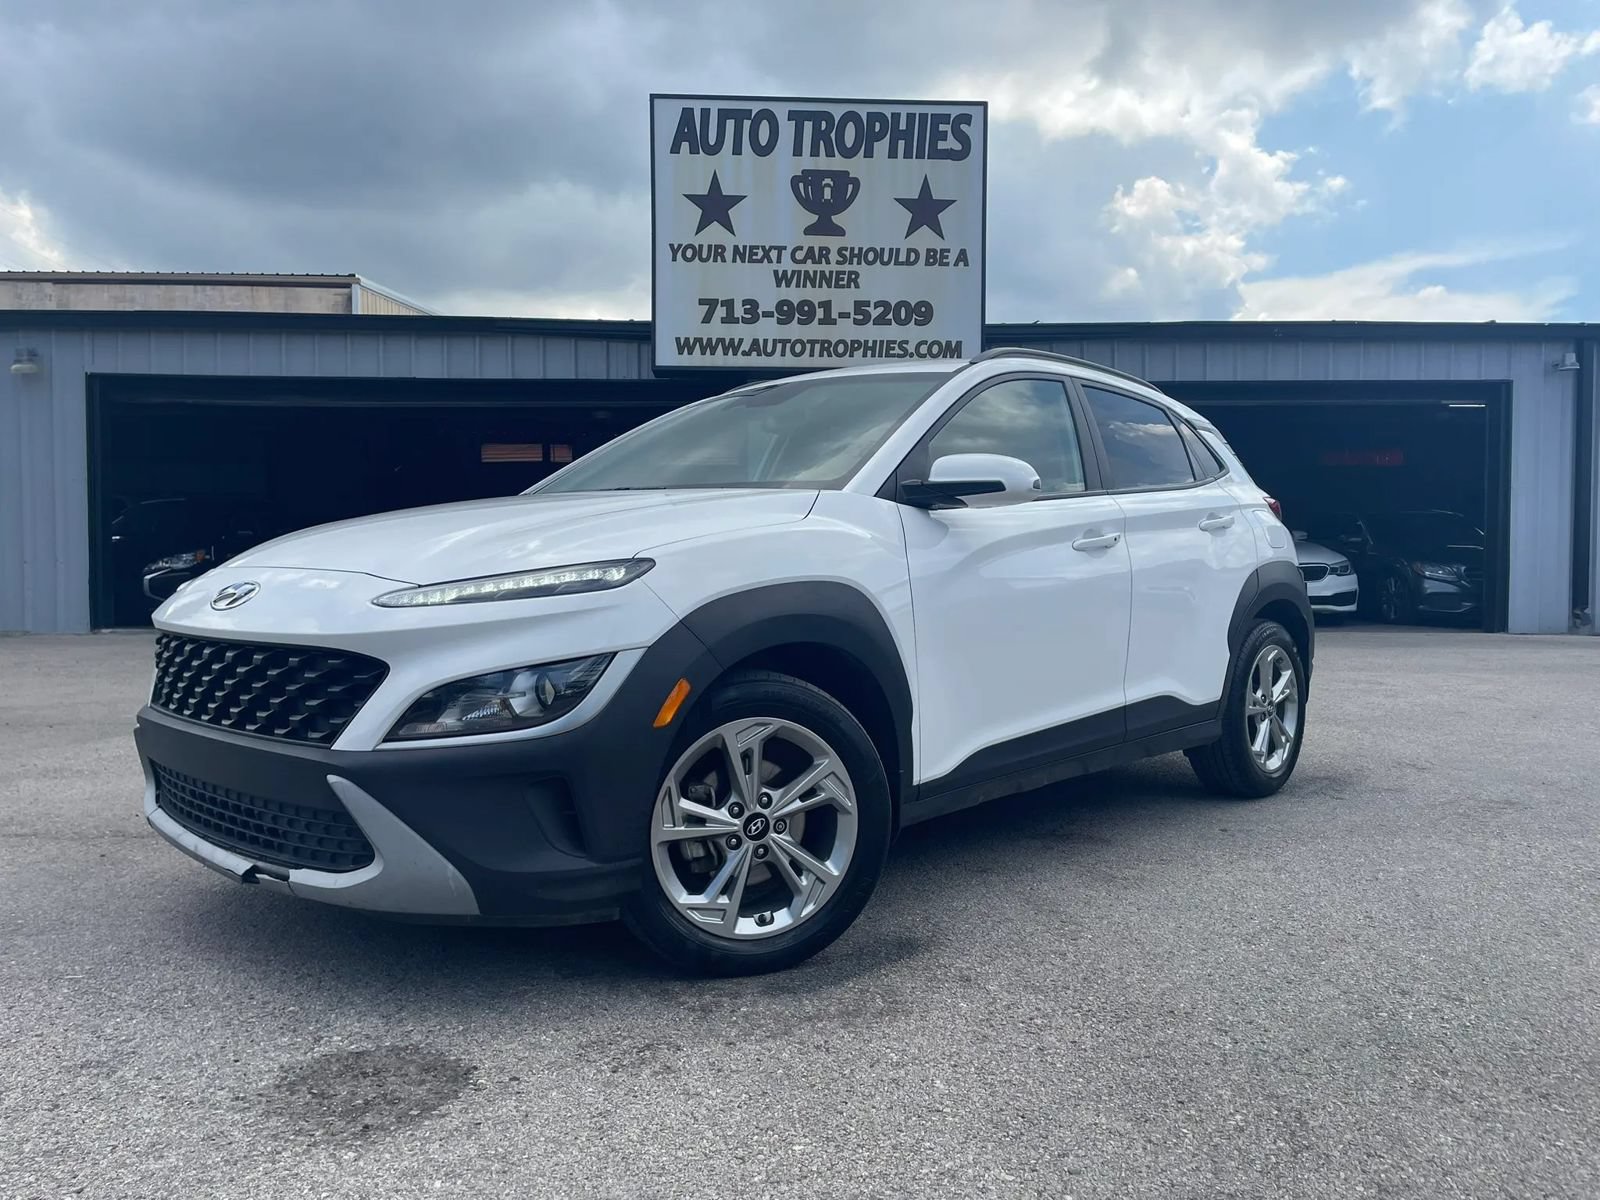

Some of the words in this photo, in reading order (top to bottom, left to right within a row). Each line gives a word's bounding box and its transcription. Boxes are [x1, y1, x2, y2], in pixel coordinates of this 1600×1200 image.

[669, 107, 780, 157] AUTO
[787, 109, 973, 161] TROPHIES
[668, 243, 727, 264] YOUR
[731, 245, 787, 265] NEXT
[790, 246, 831, 266] CAR
[835, 246, 920, 267] SHOULD
[924, 248, 951, 267] BE
[953, 248, 970, 267] A
[773, 269, 860, 289] WINNER
[698, 298, 934, 326] 713-991-5209
[675, 336, 963, 359] WWW.AUTOTROPHIES.COM
